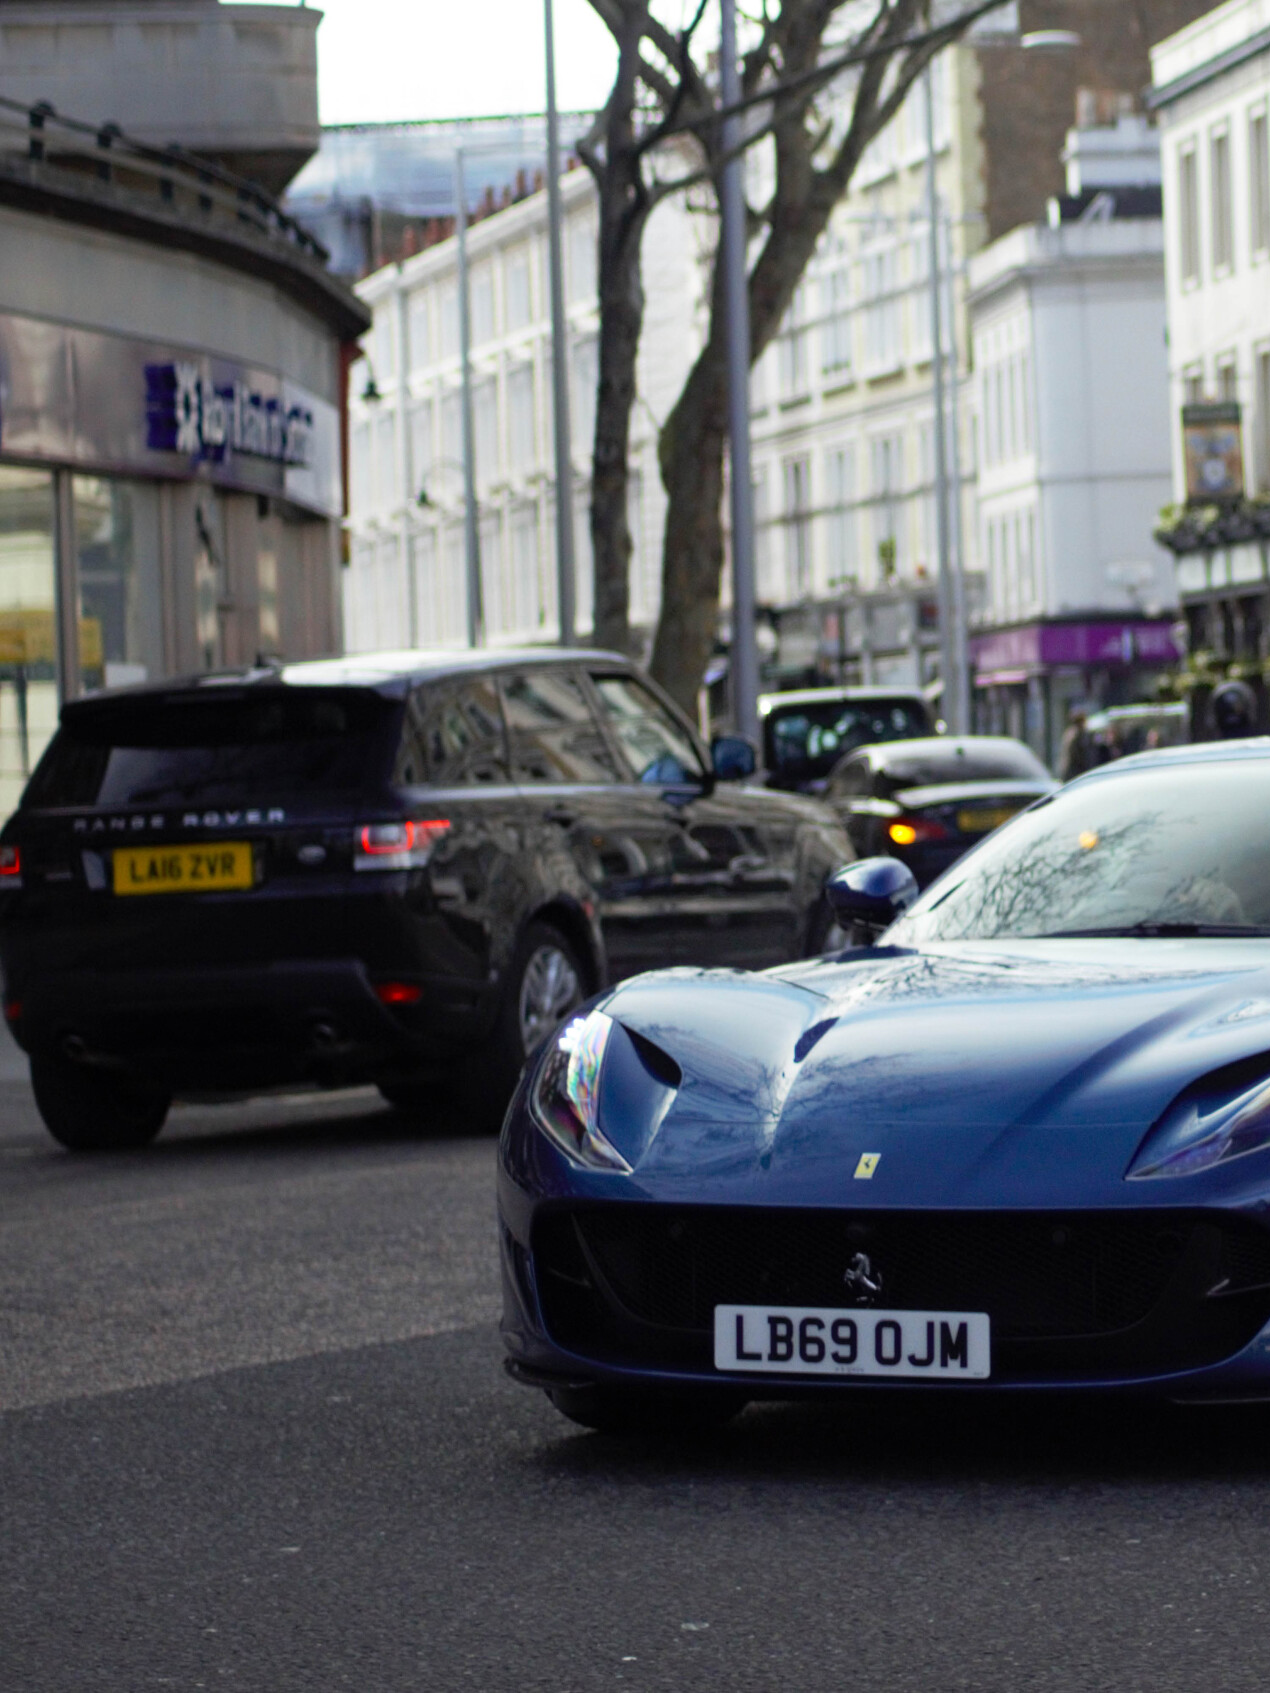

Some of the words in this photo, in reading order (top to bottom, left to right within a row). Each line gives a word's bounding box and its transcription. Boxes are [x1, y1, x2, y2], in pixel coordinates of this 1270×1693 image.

[74, 814, 164, 831] RANGE
[182, 808, 285, 828] ROVER
[129, 855, 183, 883] LA16
[189, 851, 236, 881] ZVR
[735, 1314, 858, 1365] LB69
[874, 1319, 968, 1368] OJM
